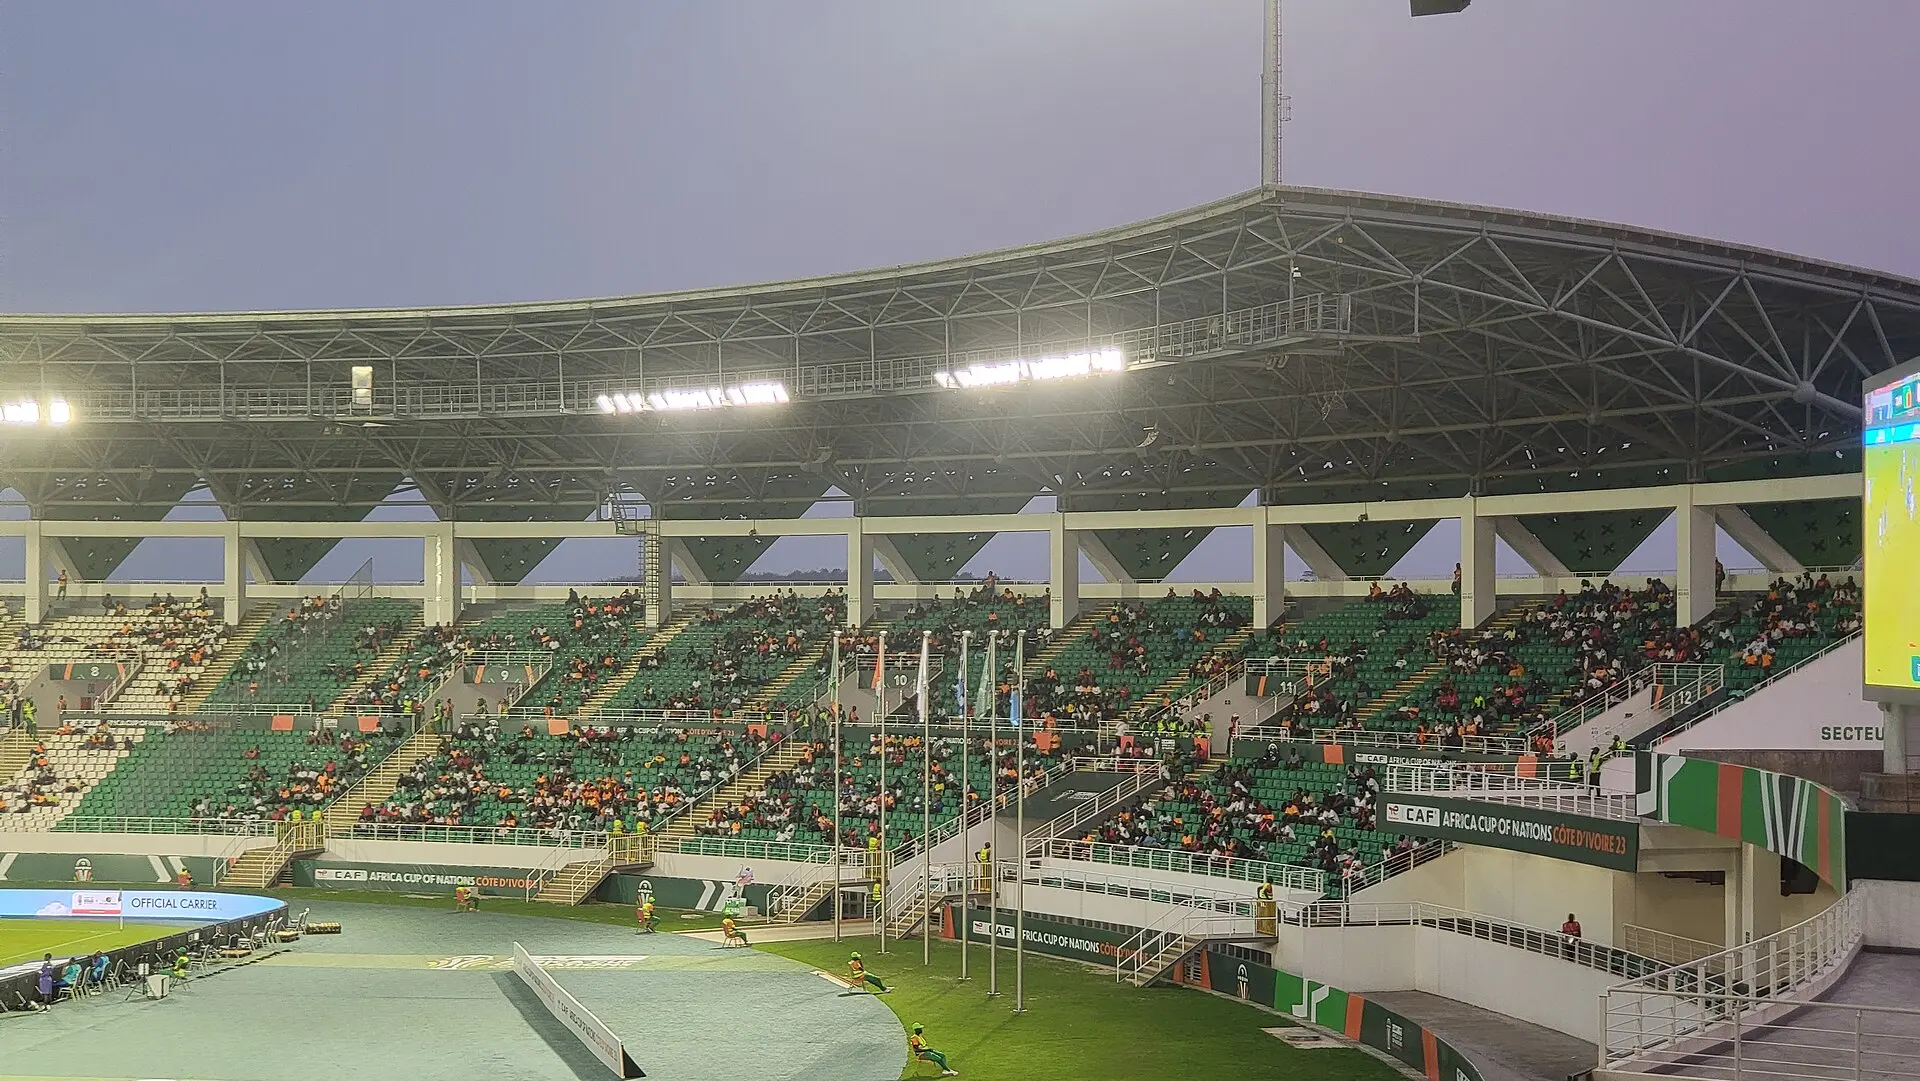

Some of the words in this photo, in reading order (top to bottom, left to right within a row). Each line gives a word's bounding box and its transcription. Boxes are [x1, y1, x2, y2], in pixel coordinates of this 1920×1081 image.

[90, 666, 99, 677] 8
[500, 670, 509, 681] 9
[893, 674, 908, 686] 10
[1280, 681, 1293, 694] 11
[1678, 690, 1692, 705] 12
[1821, 726, 1884, 741] SECTEU
[1406, 808, 1434, 823] CAF
[1443, 811, 1478, 831] AFRICA
[1478, 815, 1497, 833] CUP
[1498, 818, 1511, 835] OF
[1512, 820, 1553, 842] NATIONS
[1553, 823, 1576, 846] CÔTE
[1615, 836, 1626, 855] 23
[335, 871, 361, 879] CAF
[369, 871, 402, 882] AFRICA
[403, 873, 422, 883] CUP
[422, 874, 436, 884] OF
[436, 875, 476, 886] NATIONS
[476, 875, 499, 887] CÔTE
[131, 898, 178, 909] OFFICIAL
[180, 898, 218, 910] CARRIER
[1043, 933, 1058, 946] CUP
[1058, 935, 1069, 947] OF
[1068, 938, 1100, 954] NATIONS
